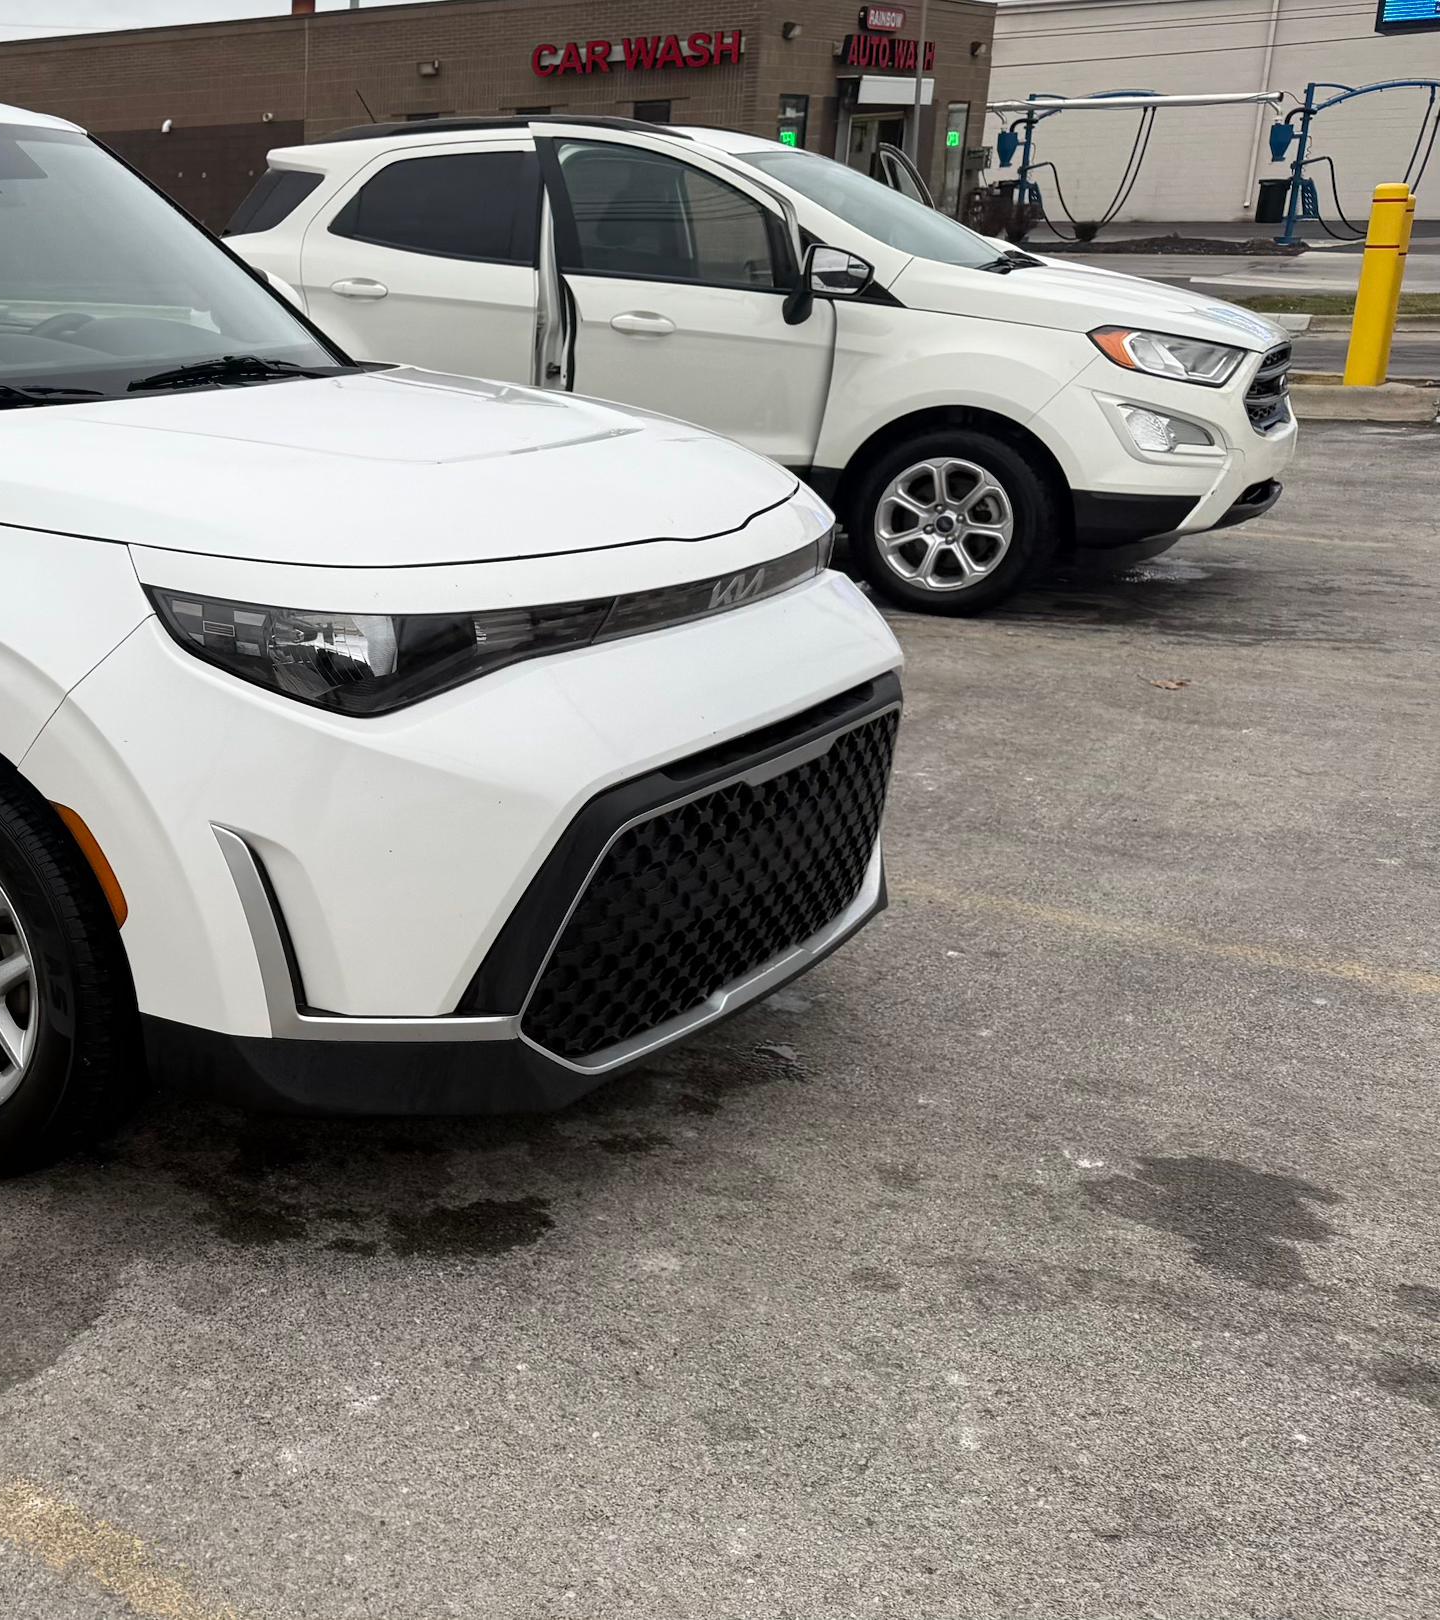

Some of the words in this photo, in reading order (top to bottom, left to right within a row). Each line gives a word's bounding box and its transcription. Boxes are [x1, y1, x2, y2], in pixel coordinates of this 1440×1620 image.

[531, 39, 612, 77] CAR
[622, 29, 742, 72] WASH
[848, 35, 890, 70] AUTO
[894, 40, 936, 71] WAH
[708, 568, 765, 609] KIA
